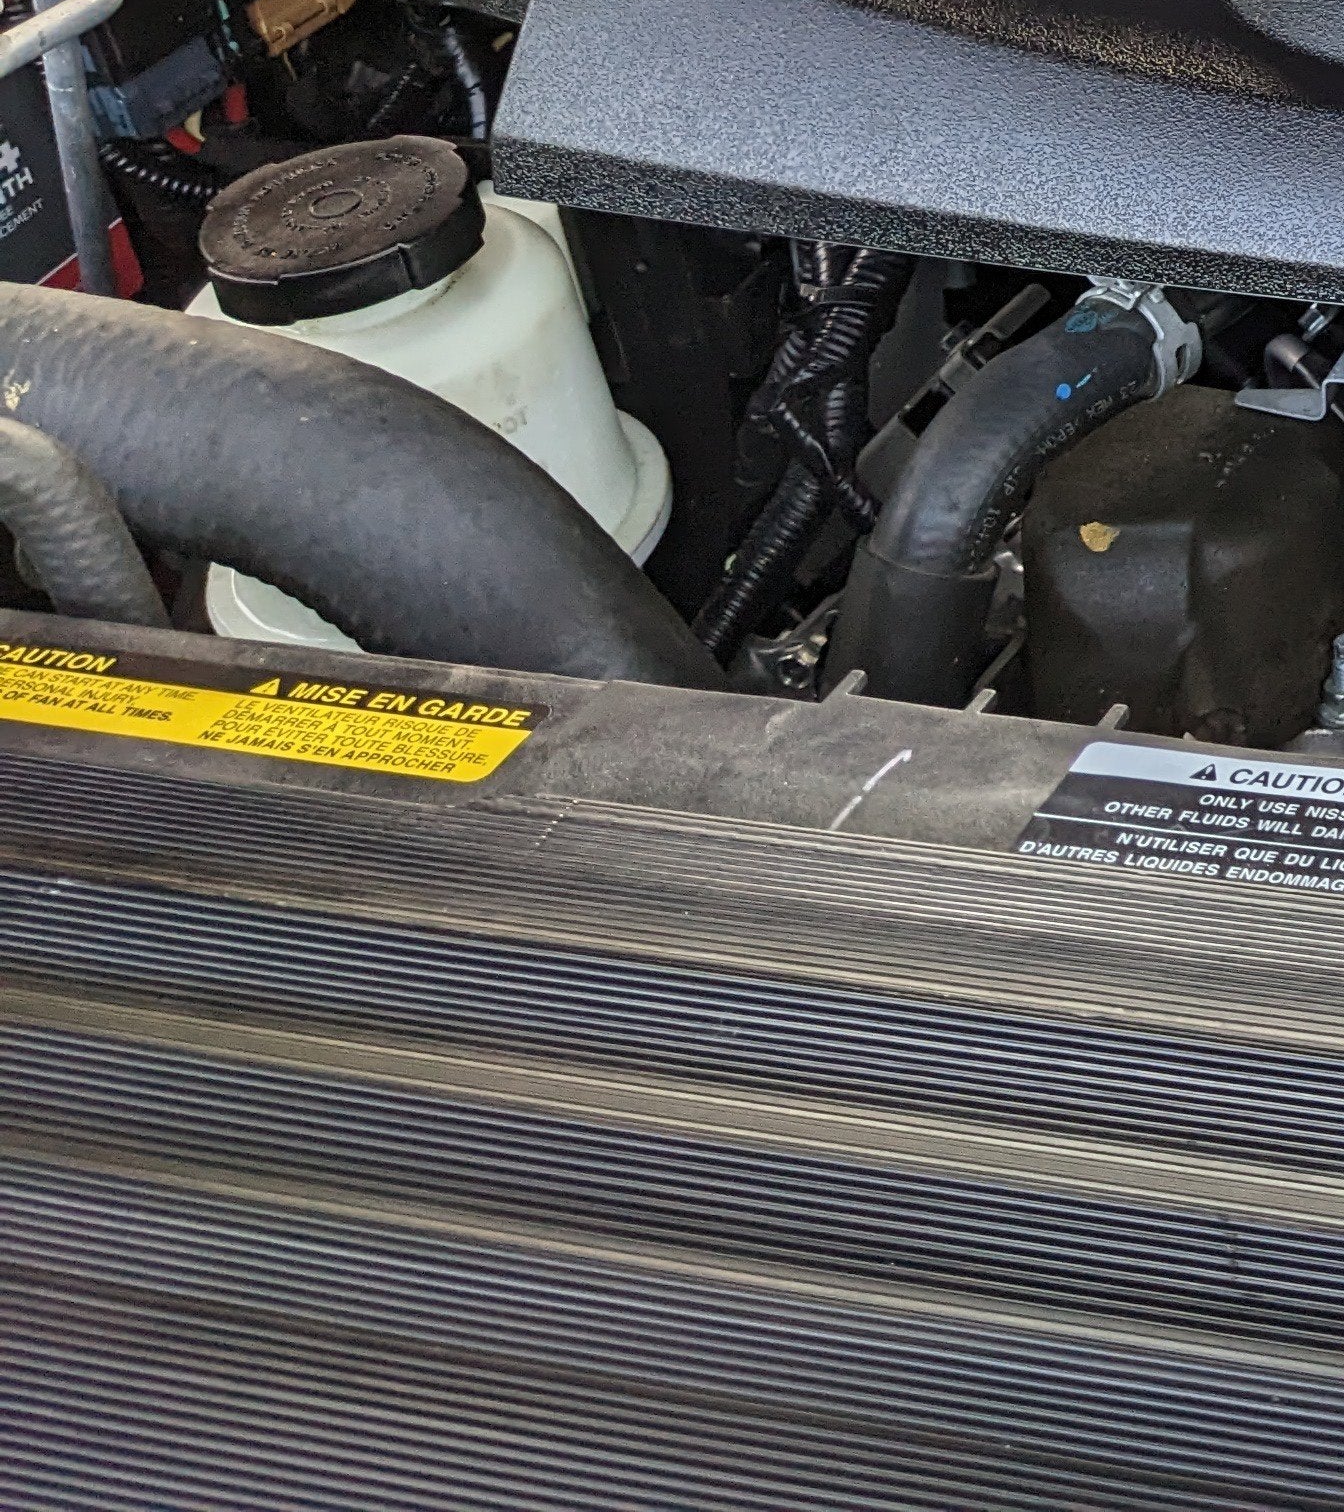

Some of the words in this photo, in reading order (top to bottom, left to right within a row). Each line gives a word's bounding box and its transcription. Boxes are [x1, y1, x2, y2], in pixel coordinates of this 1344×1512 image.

[2, 690, 29, 701] OF
[29, 694, 61, 706] FAN
[65, 699, 87, 709] AT
[85, 702, 116, 714] ALL
[235, 699, 260, 709] LE
[263, 702, 380, 725] VENTILATEUR
[382, 718, 449, 734] RISQUE
[454, 727, 483, 738] DE
[287, 682, 369, 706] MISE
[367, 692, 417, 712] EN
[418, 699, 532, 727] GARDE
[210, 720, 262, 734] POUR
[331, 735, 391, 752] TOUTE
[342, 723, 392, 739] TOUT
[198, 730, 225, 741] NE
[226, 735, 296, 751] JAMAIS
[297, 744, 341, 758] S'EN
[341, 749, 457, 773] APPROCHER
[1104, 801, 1173, 820] OTHER
[1178, 810, 1250, 829] FLUIDS
[1257, 819, 1302, 835] WILL
[1200, 794, 1253, 810] ONLY
[1258, 800, 1300, 816] USE
[1019, 841, 1119, 863] D'AUTRES
[1124, 854, 1220, 876] LIQUIDES
[1116, 832, 1227, 857] N'UTILISER
[1234, 848, 1278, 863] QUE
[1284, 854, 1315, 867] DU
